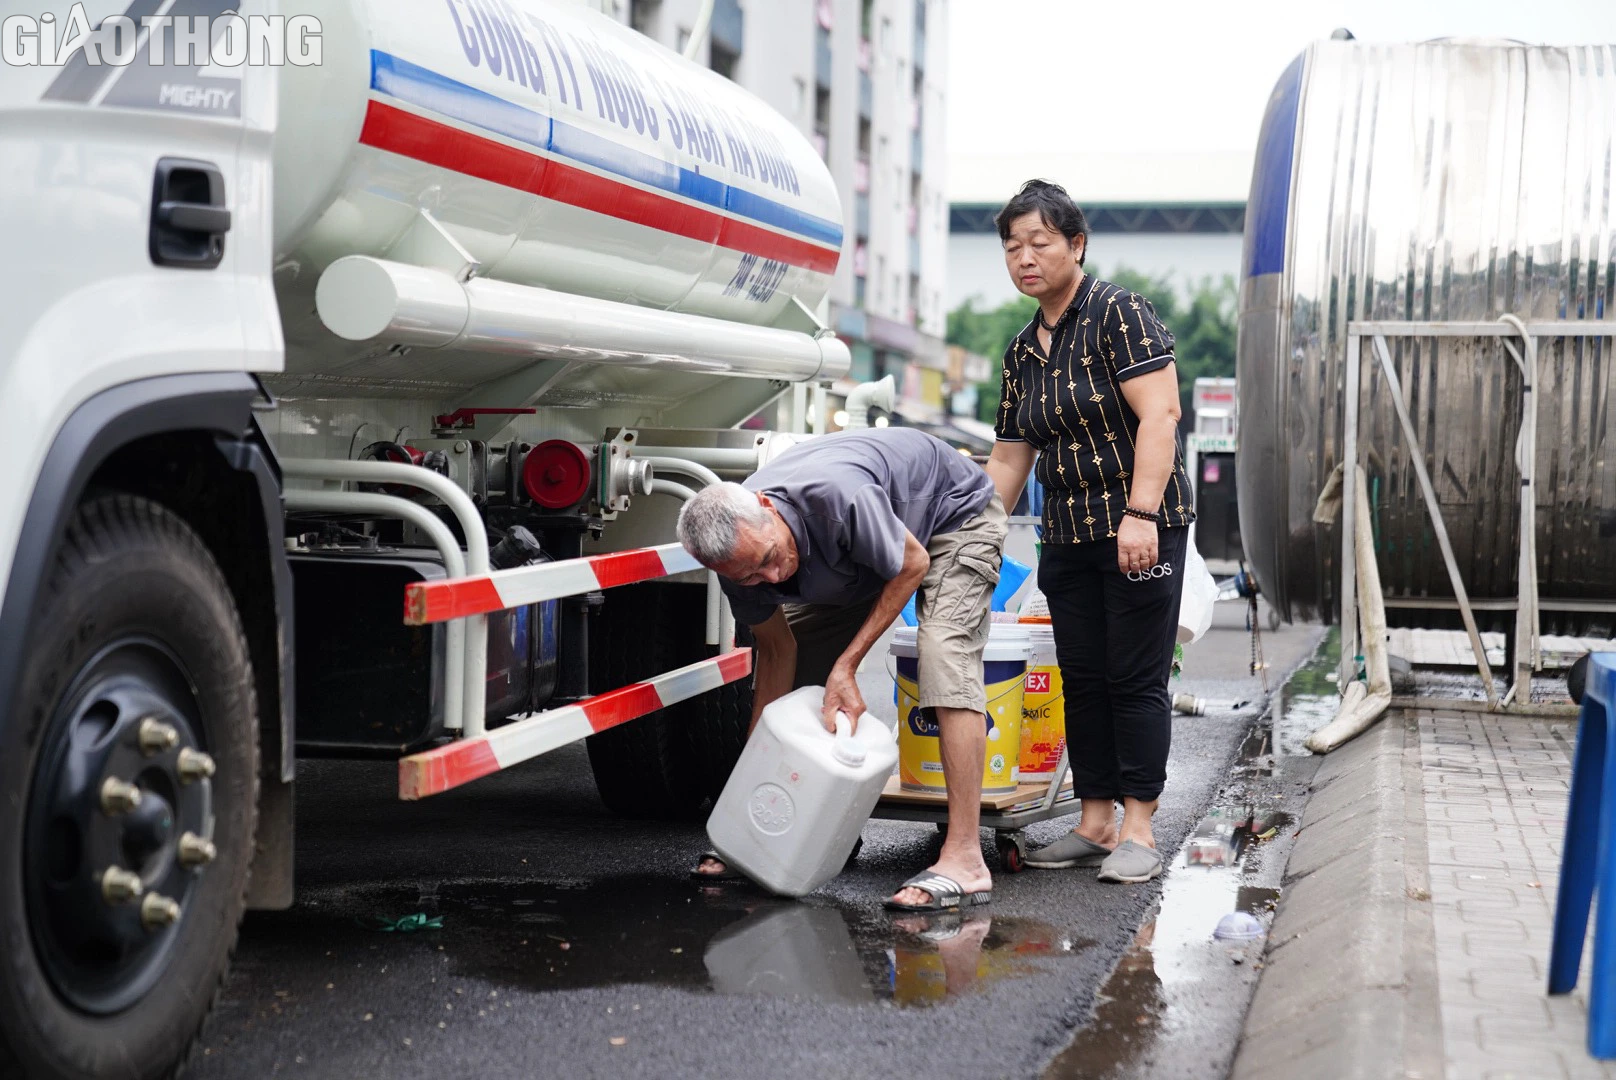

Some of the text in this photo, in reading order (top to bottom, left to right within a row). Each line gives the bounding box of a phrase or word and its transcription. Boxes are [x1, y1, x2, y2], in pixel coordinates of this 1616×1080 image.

[523, 11, 583, 111] TY
[159, 83, 236, 109] MIGHTY
[1025, 675, 1047, 690] EX
